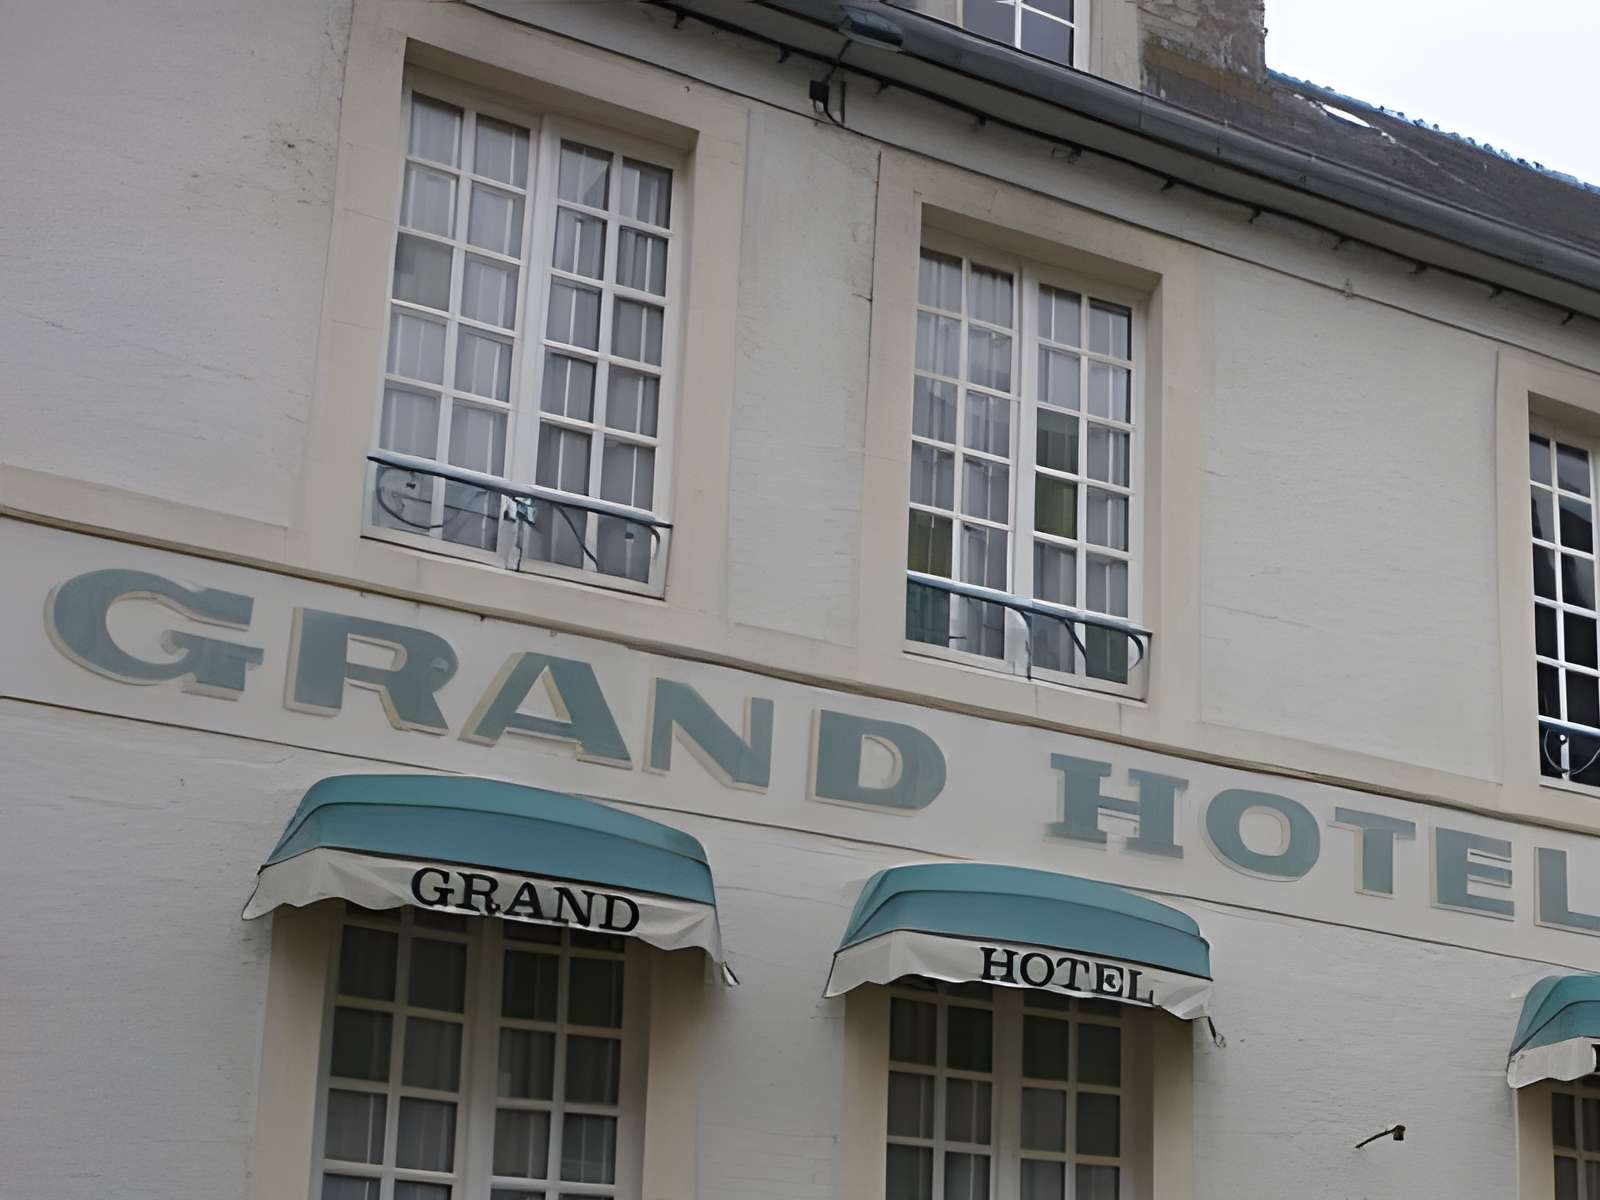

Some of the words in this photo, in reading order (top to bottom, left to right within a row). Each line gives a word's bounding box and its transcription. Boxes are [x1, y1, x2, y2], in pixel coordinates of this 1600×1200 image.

[44, 567, 948, 817] GRAND
[411, 867, 640, 933] GRAND
[979, 946, 1156, 1007] HOTEL
